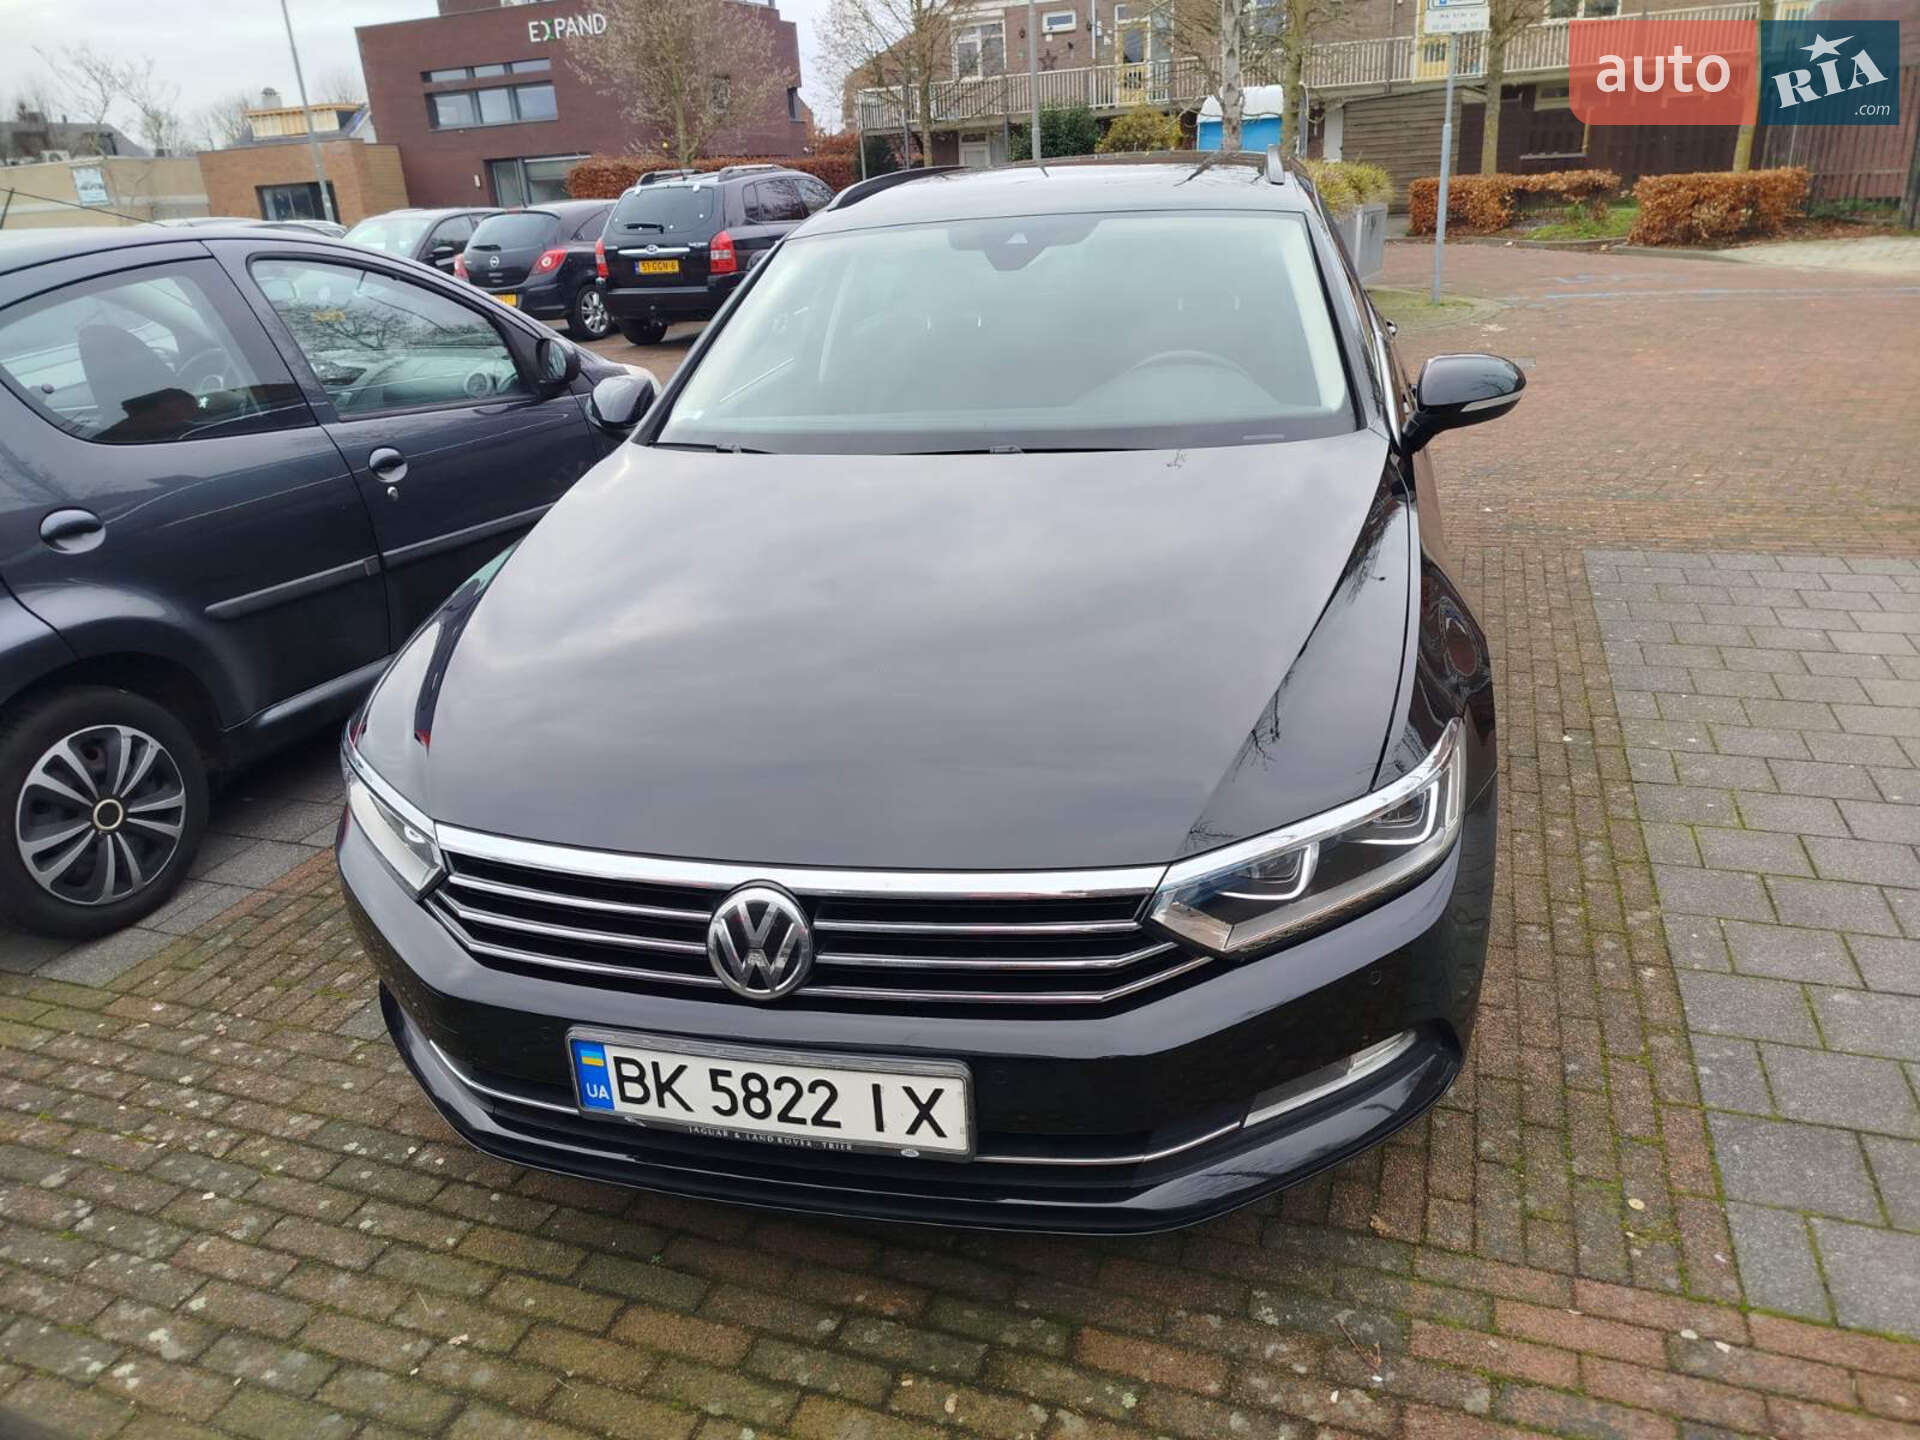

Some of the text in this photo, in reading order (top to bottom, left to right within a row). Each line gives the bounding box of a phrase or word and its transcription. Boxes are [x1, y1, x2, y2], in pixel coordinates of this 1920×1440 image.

[528, 12, 607, 42] EXPAND
[586, 1082, 610, 1100] UA
[613, 1056, 695, 1113] BK
[709, 1068, 842, 1129] 5822
[689, 1126, 729, 1138] JAGUAR
[746, 1134, 773, 1143] LAND
